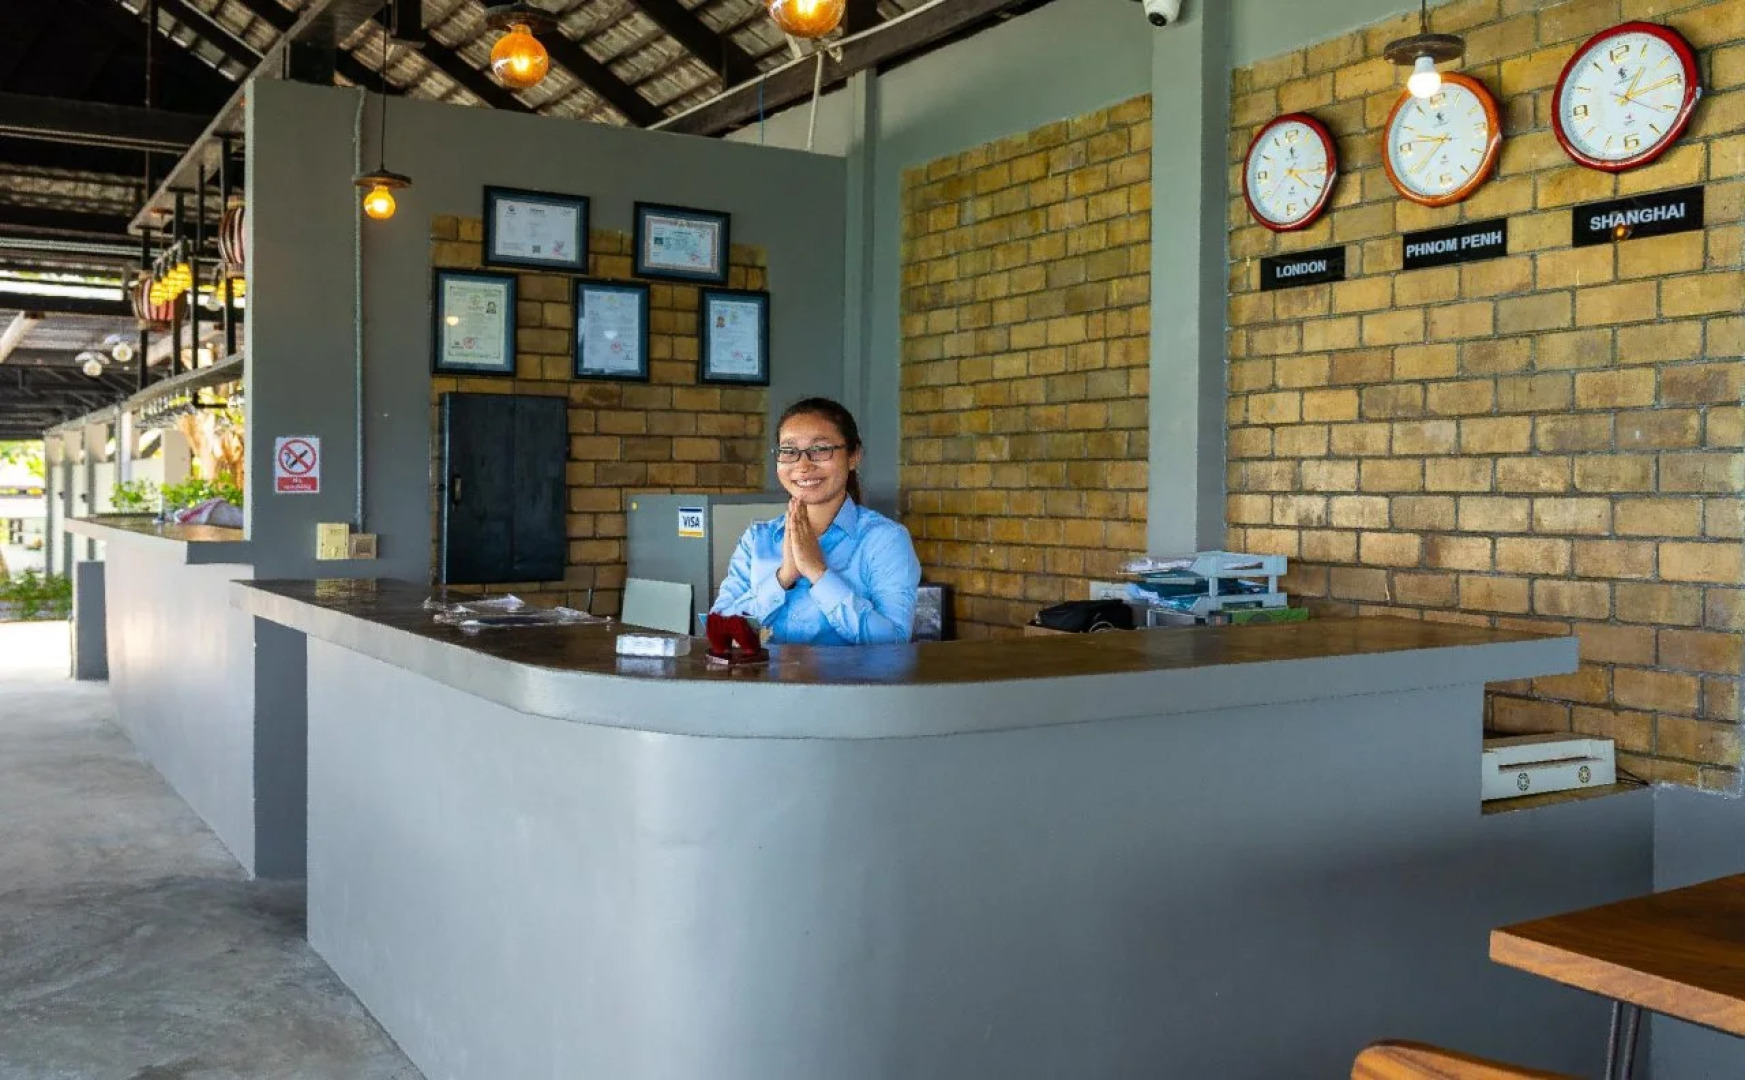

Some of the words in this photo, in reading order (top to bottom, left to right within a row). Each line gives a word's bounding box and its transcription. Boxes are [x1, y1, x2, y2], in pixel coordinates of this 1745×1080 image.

[1624, 133, 1640, 151] 6
[1590, 203, 1685, 230] SHANGHAI
[1406, 238, 1457, 258] PHNOM
[1461, 230, 1502, 249] PENH
[1276, 260, 1327, 278] LONDON
[683, 516, 700, 528] VISA
